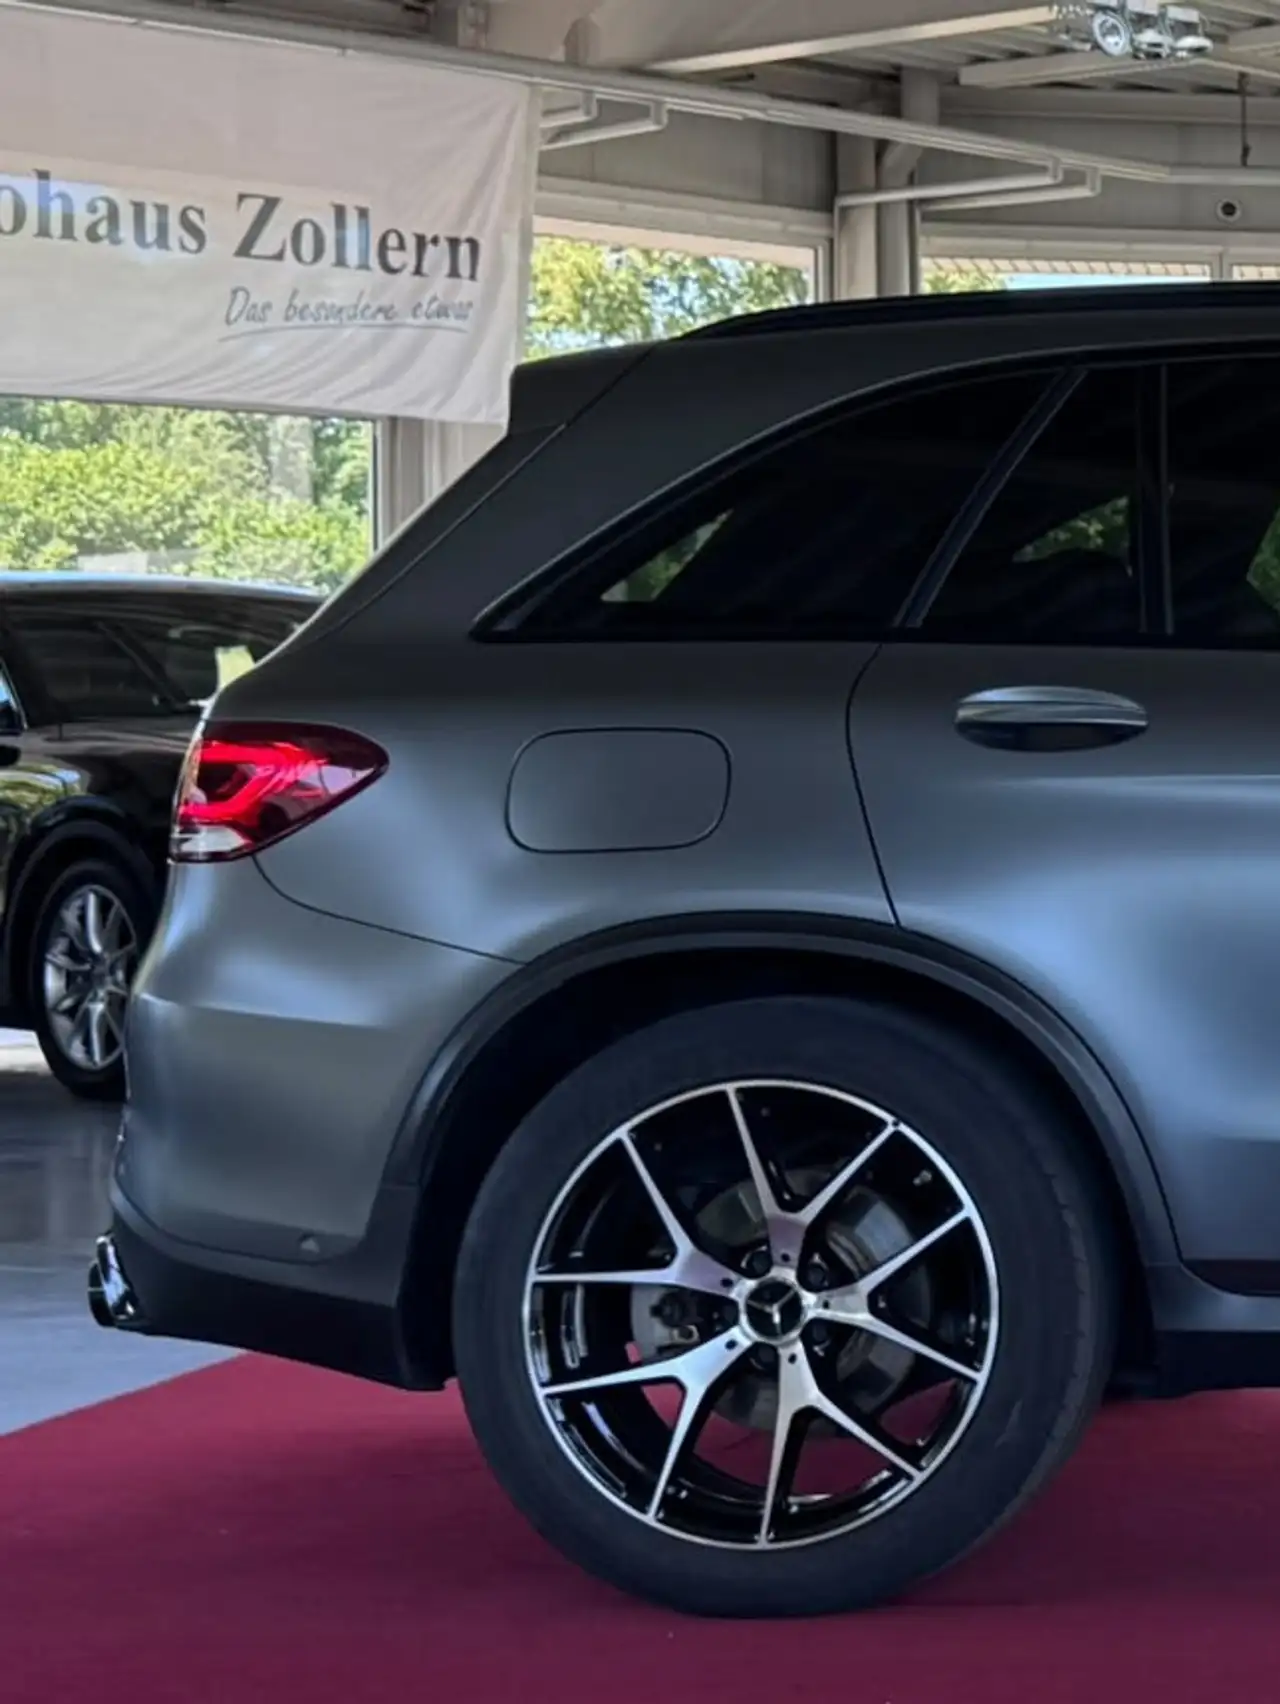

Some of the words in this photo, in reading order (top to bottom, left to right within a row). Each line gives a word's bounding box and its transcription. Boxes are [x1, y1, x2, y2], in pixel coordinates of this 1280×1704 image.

[232, 192, 481, 282] Zollern
[225, 285, 273, 327] Das
[283, 287, 398, 323] besondere
